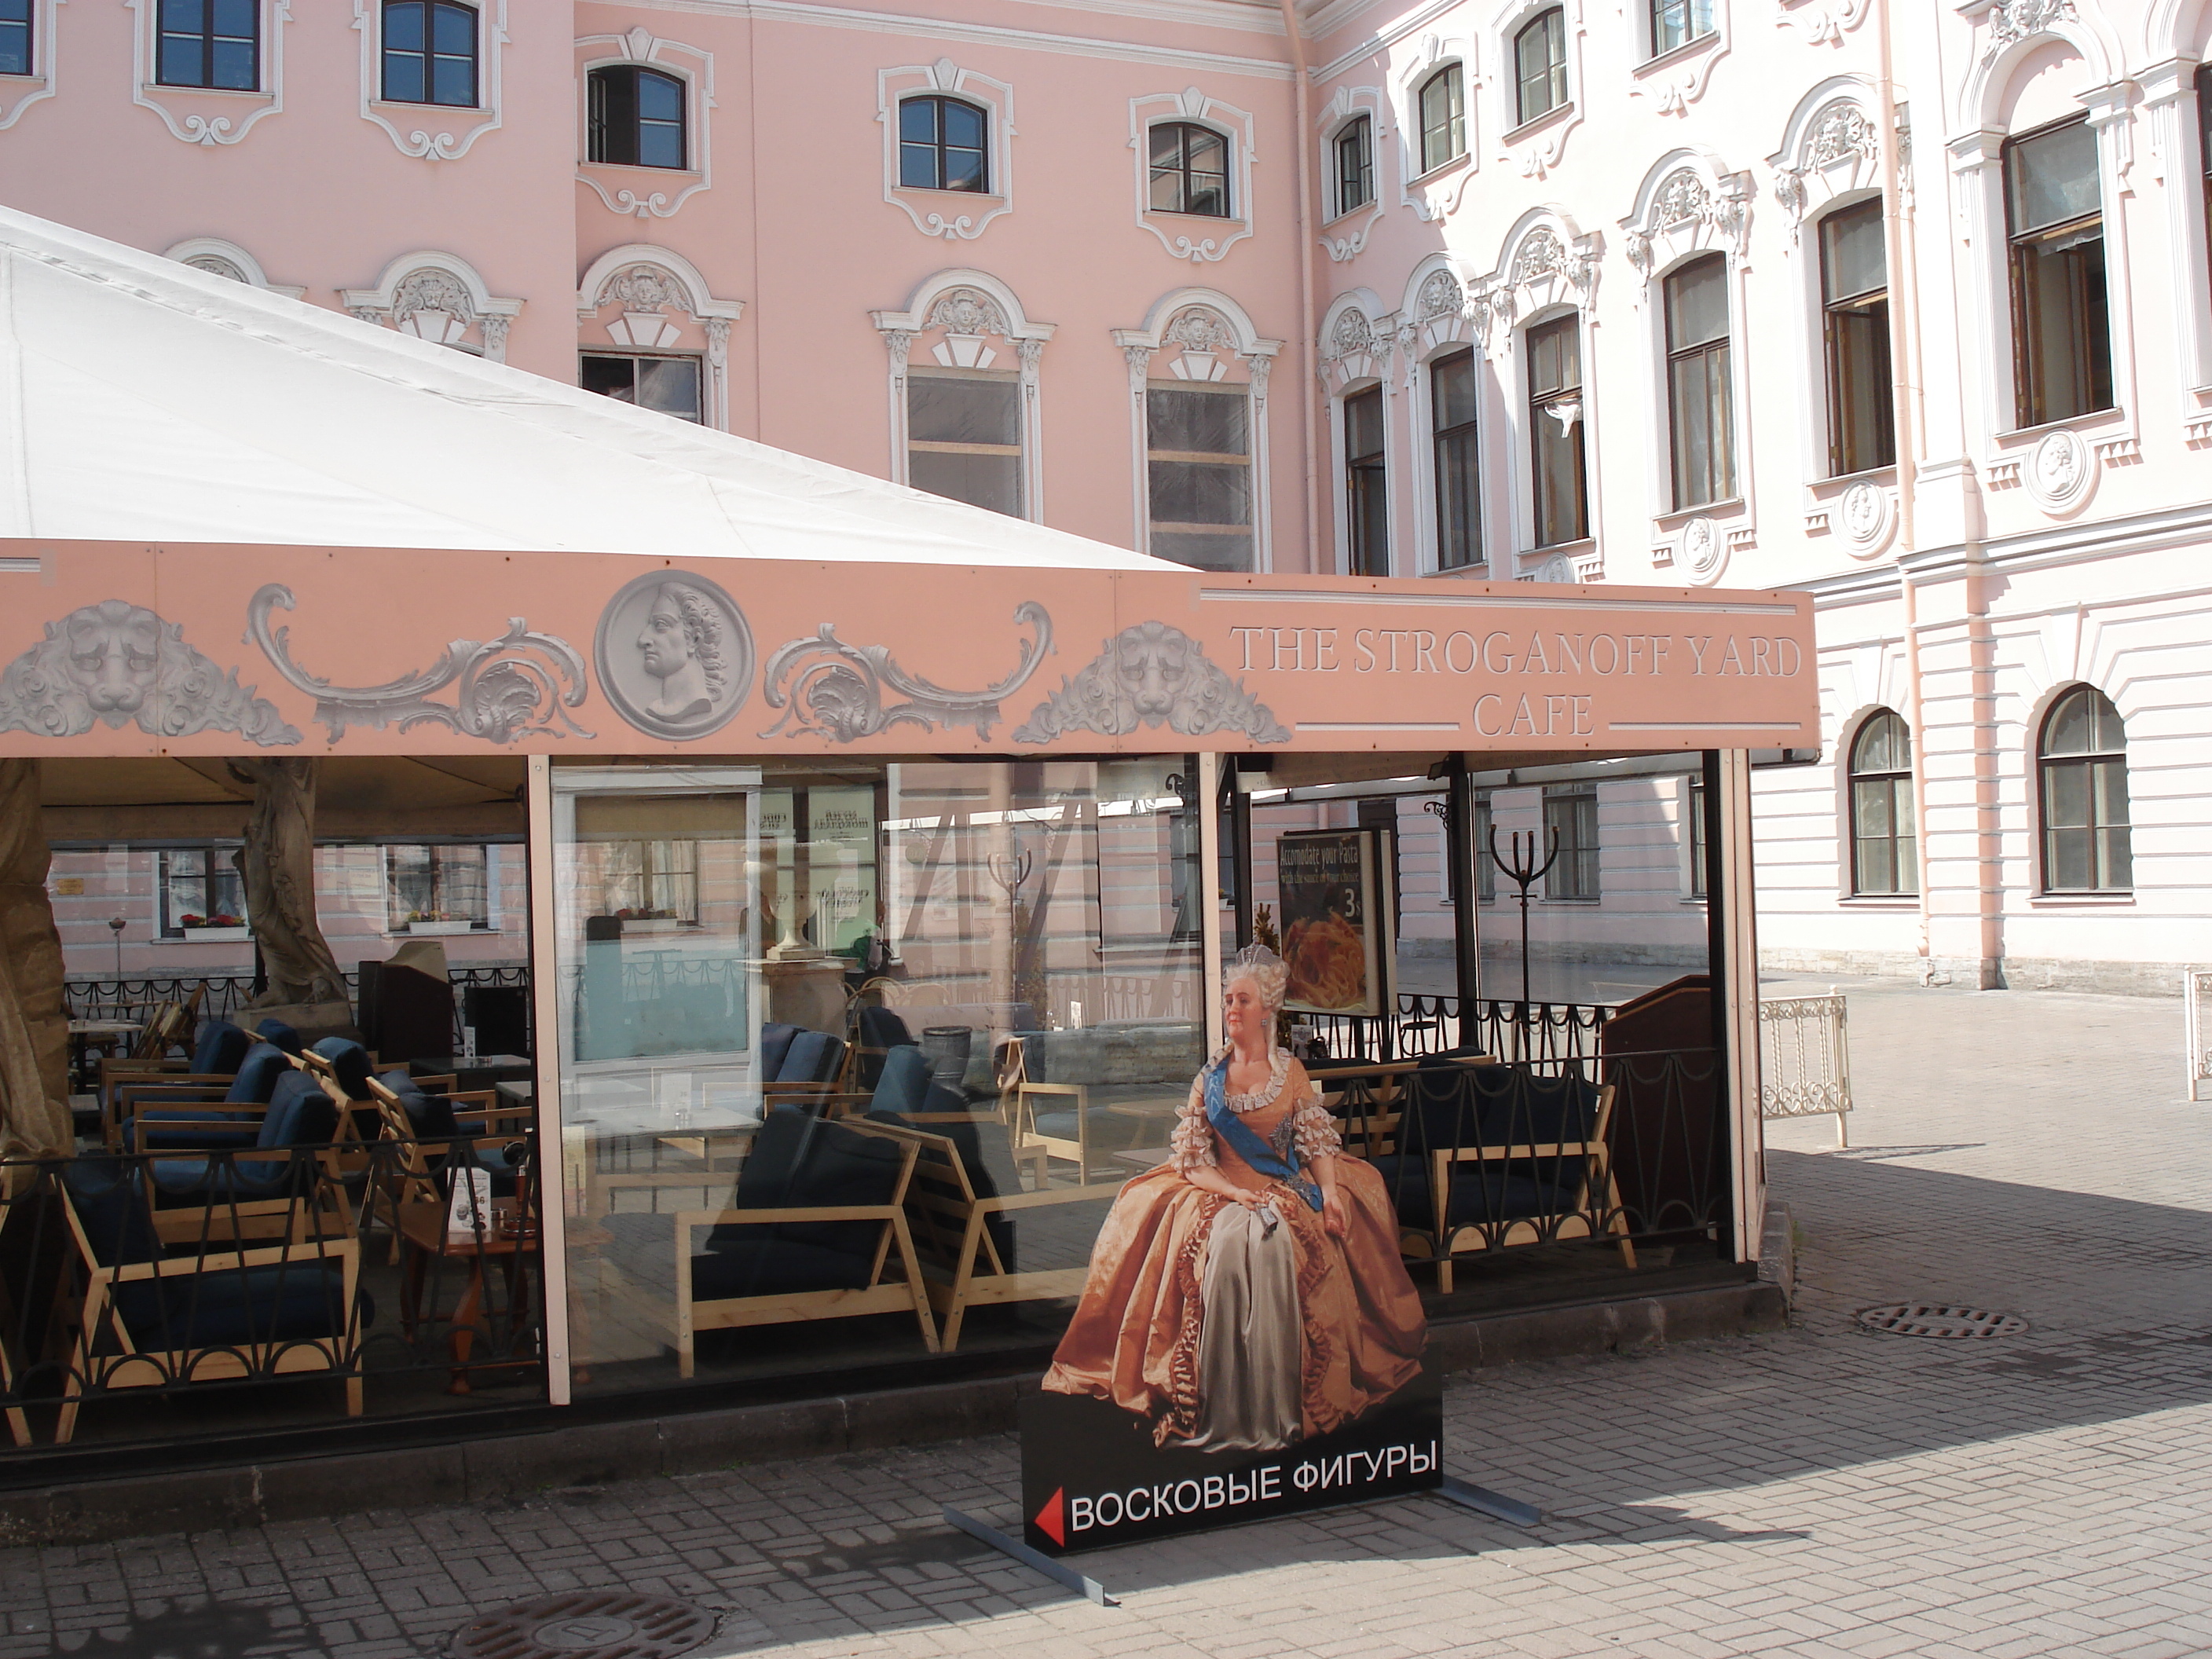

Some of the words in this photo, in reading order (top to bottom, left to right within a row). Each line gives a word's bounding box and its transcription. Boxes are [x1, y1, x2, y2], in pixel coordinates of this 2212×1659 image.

[1229, 626, 1339, 672] THE
[1354, 628, 1672, 676] STROGANOFF
[1685, 635, 1801, 677] YARD
[1473, 691, 1595, 738] CAFE
[1280, 843, 1320, 866] Accomodate
[1321, 847, 1338, 870] your
[1339, 841, 1358, 864] Pasta
[1071, 1466, 1282, 1532] ВОСКОВЫЕ
[1293, 1440, 1437, 1492] ФИГУРЫ
